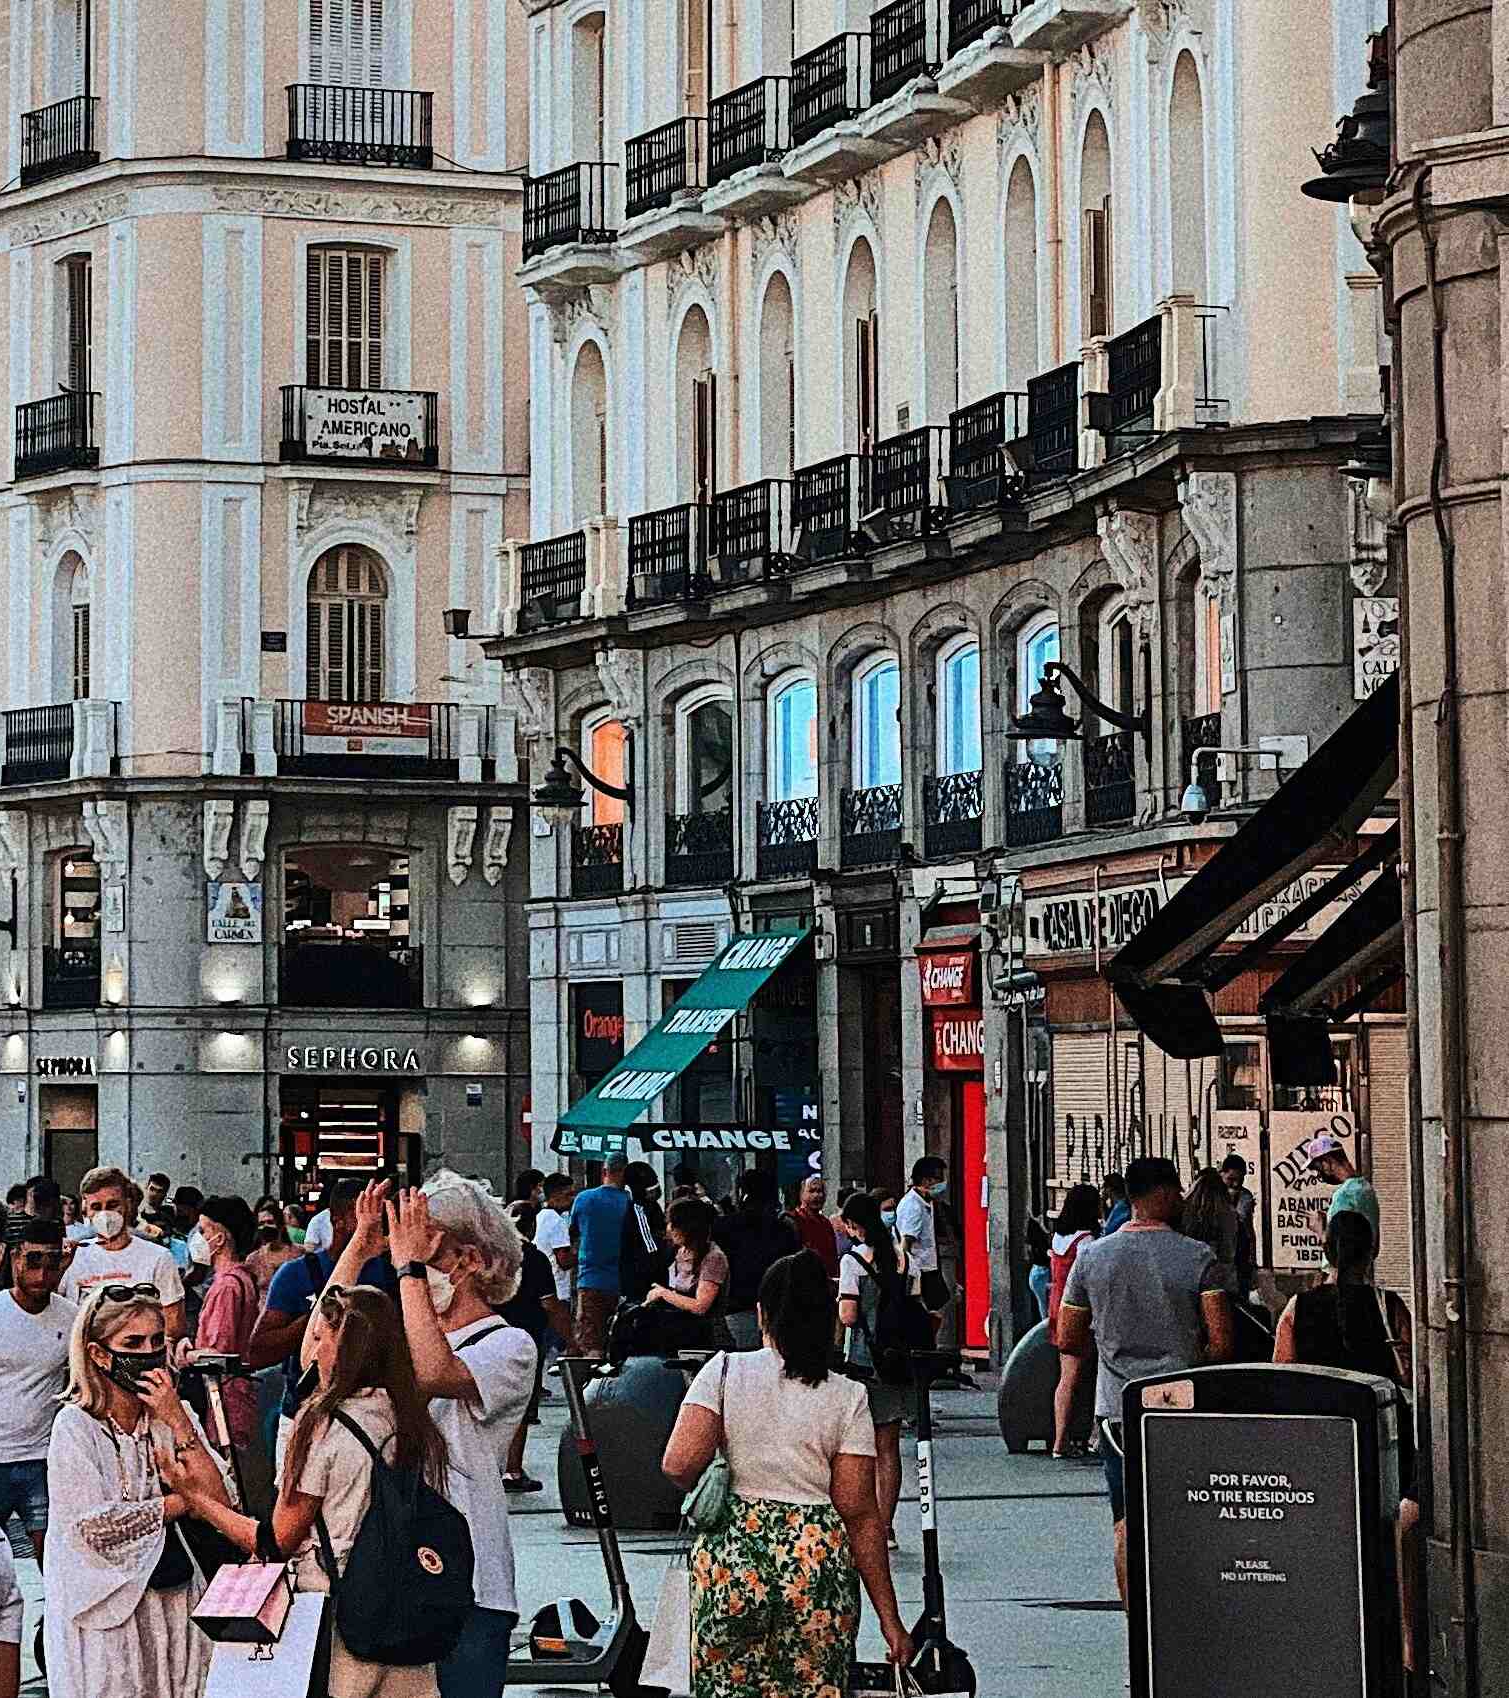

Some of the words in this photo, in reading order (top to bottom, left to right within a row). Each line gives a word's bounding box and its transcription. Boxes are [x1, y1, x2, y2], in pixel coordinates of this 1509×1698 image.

[327, 397, 386, 415] HOSTAL
[320, 420, 411, 437] AMERICANO
[327, 705, 409, 726] SPANISH
[1043, 899, 1083, 950] CASA
[718, 936, 798, 970] CHANGE
[931, 965, 964, 989] CHANGE
[942, 1020, 985, 1056] CHANG
[36, 1057, 97, 1077] SEPHORA
[287, 1045, 420, 1070] SEPHORA
[598, 1070, 677, 1100] CAMBIO
[652, 1129, 792, 1150] CHANGE
[1273, 1115, 1351, 1188] DIO
[1278, 1197, 1332, 1212] ABANIC
[1209, 1473, 1240, 1486] POR
[1241, 1474, 1292, 1489] FAVOR,
[1187, 1489, 1210, 1502] NO
[1211, 1489, 1243, 1502] TIRE
[1245, 1490, 1315, 1504] RESIDUOS
[1218, 1506, 1237, 1519] AL
[1238, 1507, 1284, 1520] SUELO
[1220, 1571, 1237, 1581] NO
[1238, 1572, 1287, 1582] LITTERING
